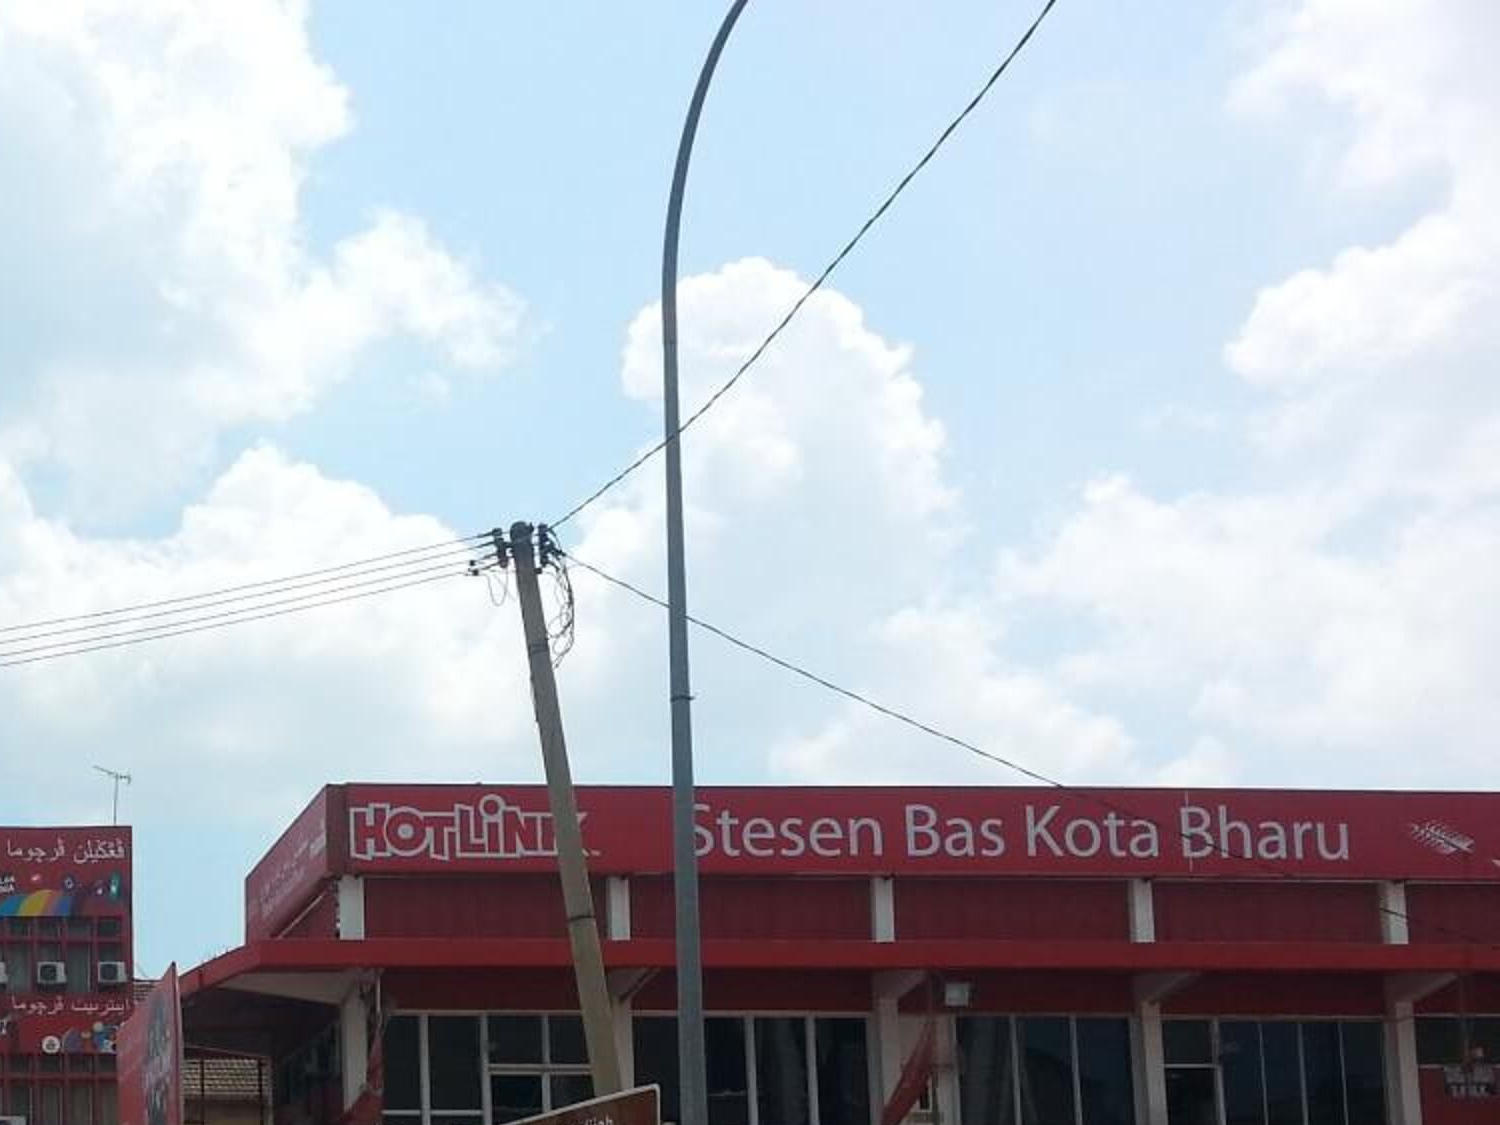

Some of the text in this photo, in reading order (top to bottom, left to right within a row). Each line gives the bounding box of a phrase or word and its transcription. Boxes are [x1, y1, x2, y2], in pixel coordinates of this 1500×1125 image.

[692, 804, 1349, 861] Stesen Bas Kota Bharu
